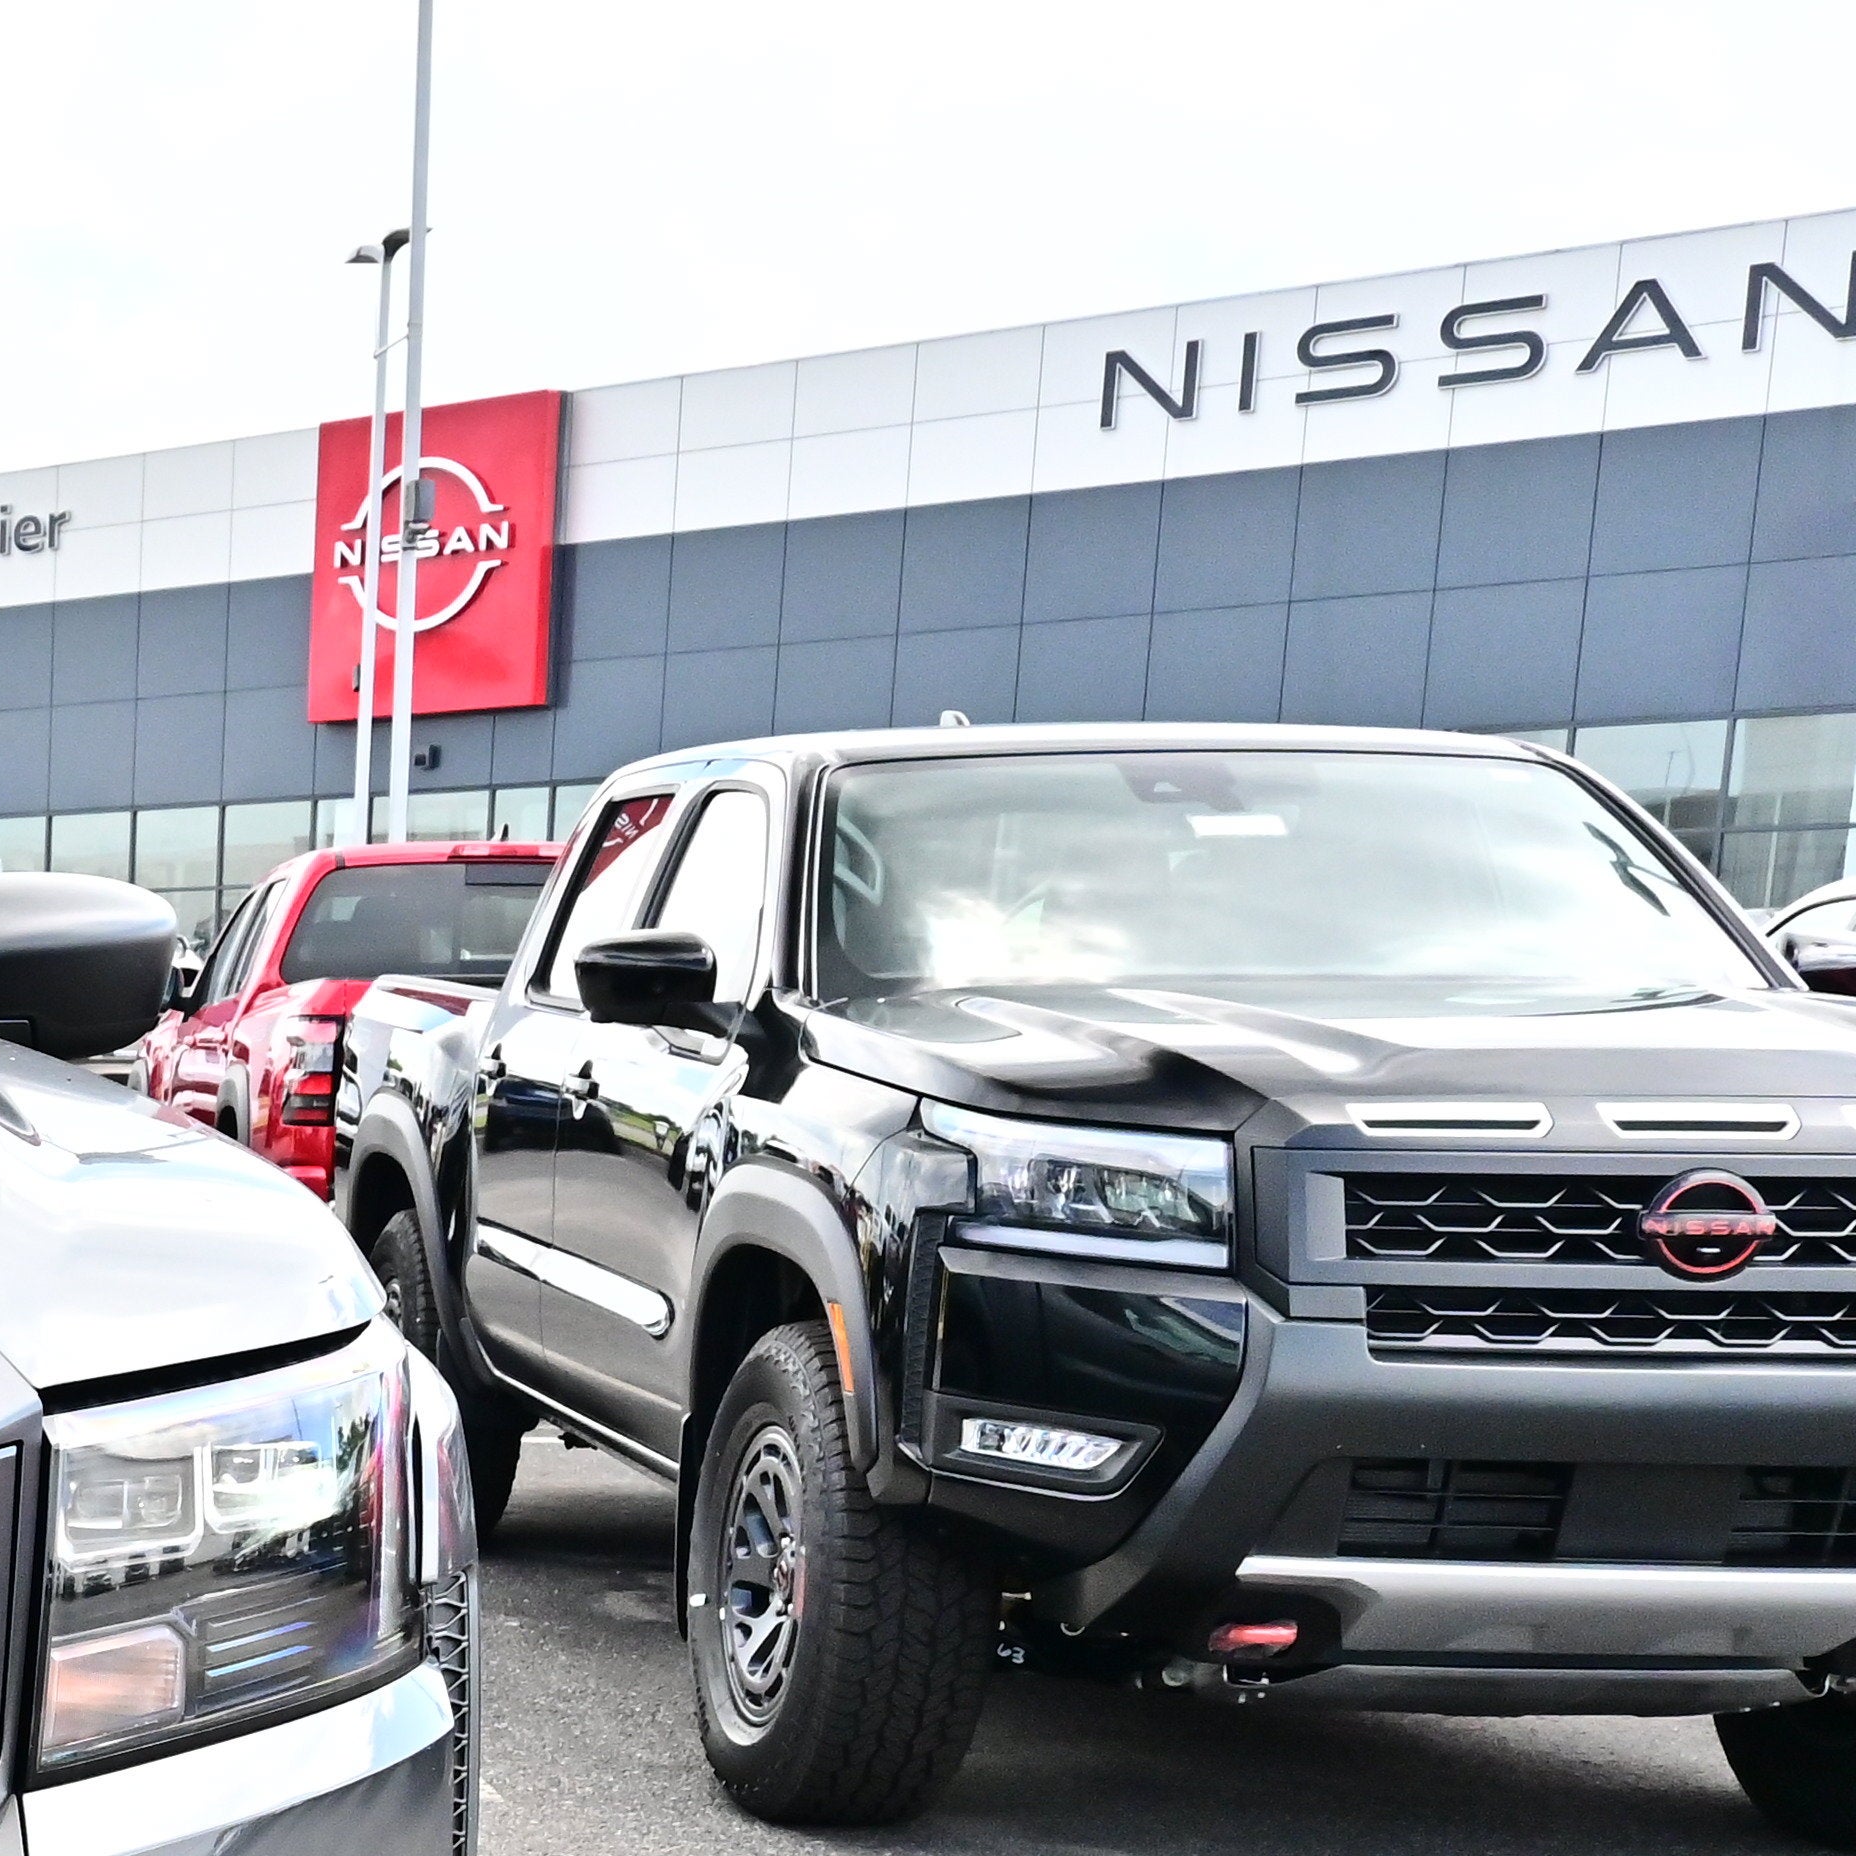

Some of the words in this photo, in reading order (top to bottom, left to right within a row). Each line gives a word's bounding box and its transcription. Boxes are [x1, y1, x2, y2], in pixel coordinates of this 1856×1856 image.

[1099, 250, 1856, 431] NISSAN
[333, 520, 511, 569] NSSAN
[1644, 1219, 1777, 1236] NISSAN
